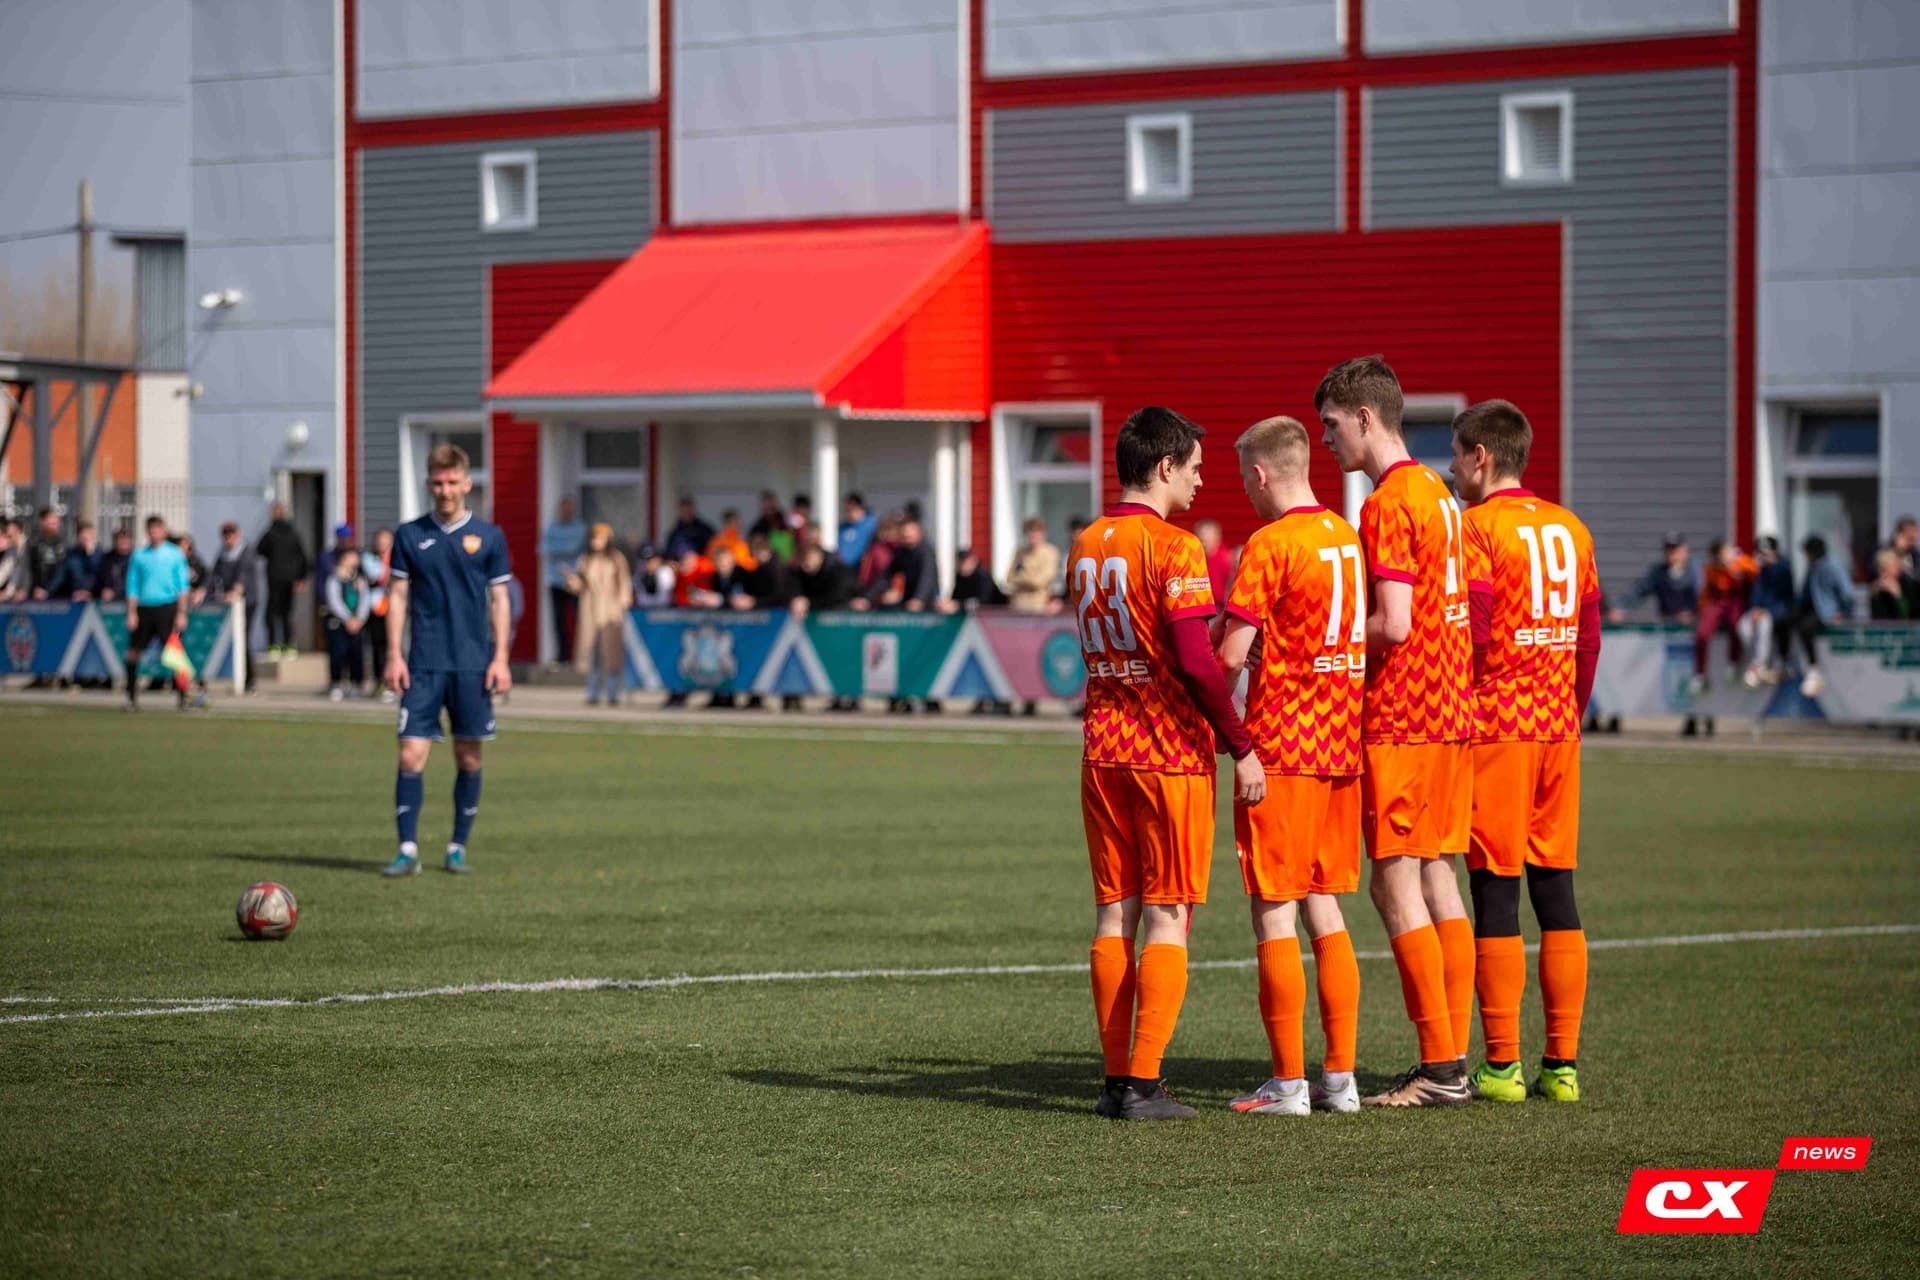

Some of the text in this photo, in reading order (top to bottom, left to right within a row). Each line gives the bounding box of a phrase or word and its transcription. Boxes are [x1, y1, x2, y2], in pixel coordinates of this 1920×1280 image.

[1516, 523, 1577, 620] 19
[1075, 556, 1136, 653] 23
[1312, 652, 1366, 673] SEU
[1513, 625, 1578, 647] SEUS
